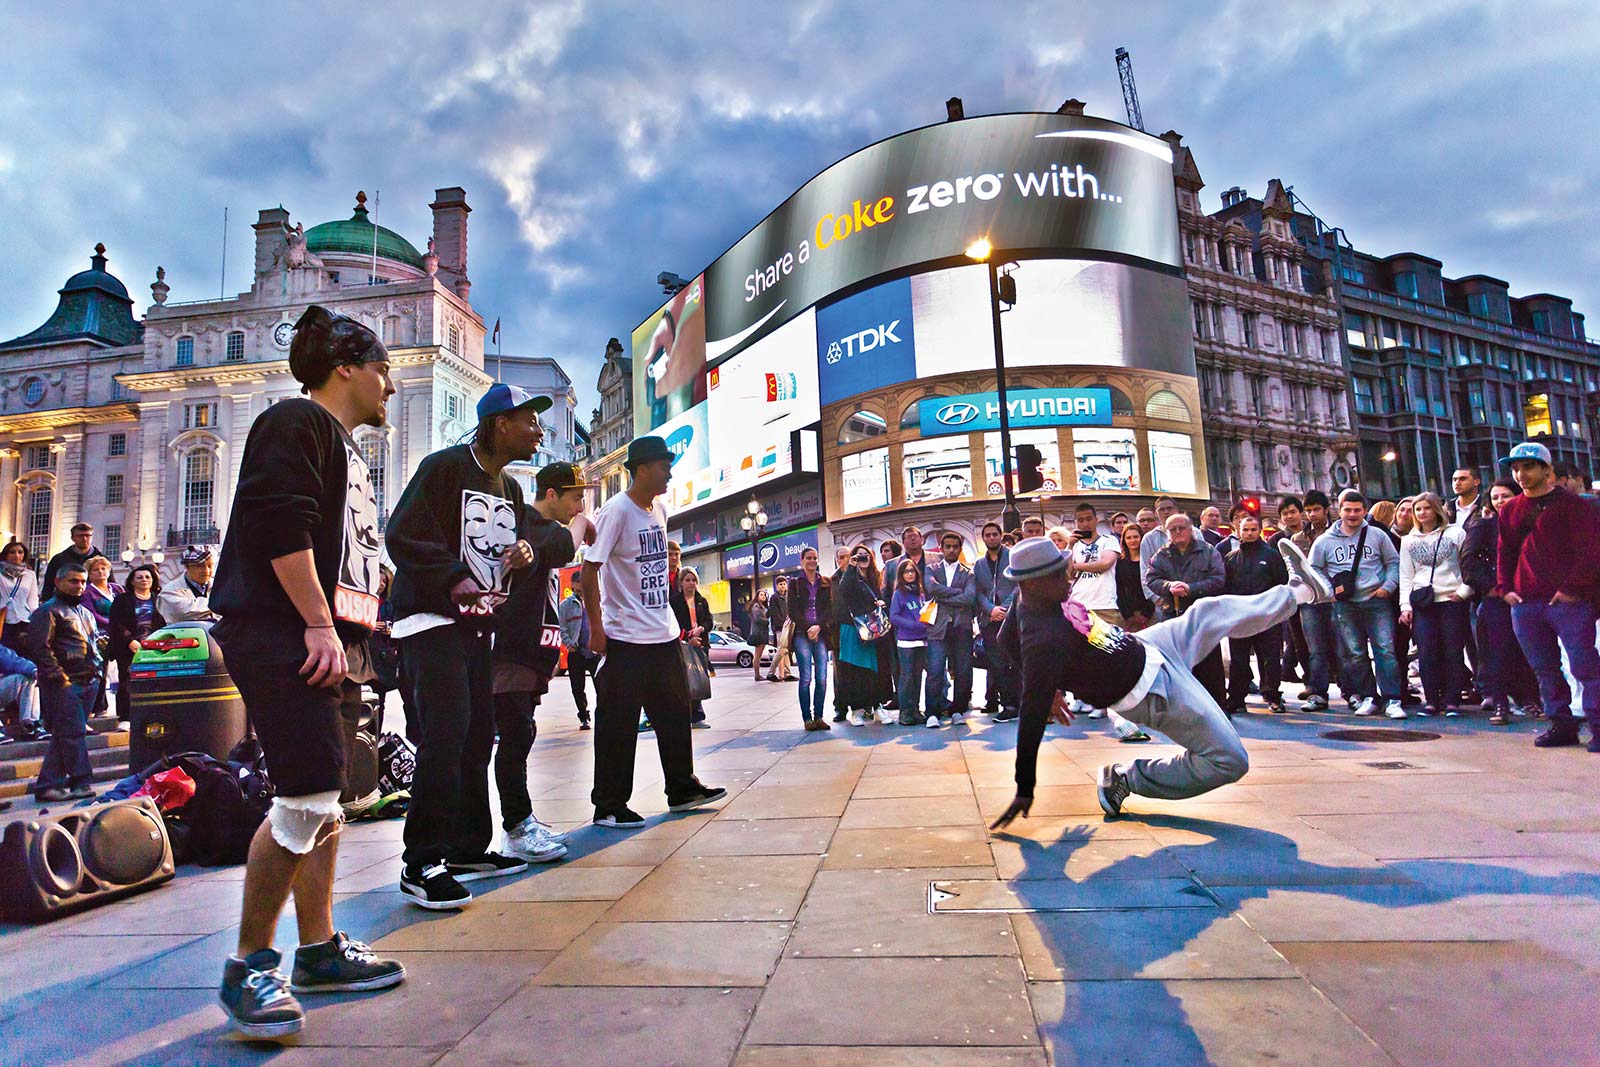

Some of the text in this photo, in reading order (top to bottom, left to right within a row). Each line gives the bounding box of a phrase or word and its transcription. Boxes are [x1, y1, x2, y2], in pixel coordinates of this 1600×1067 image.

[745, 251, 794, 303] Share
[798, 239, 810, 264] a
[814, 194, 895, 251] Coke
[906, 173, 1003, 214] zero
[1014, 163, 1123, 204] with...
[841, 319, 902, 358] TDK
[985, 397, 1097, 420] HYUNDAI
[639, 530, 667, 554] HUMB
[1334, 543, 1373, 563] GAP
[641, 575, 667, 590] GRE
